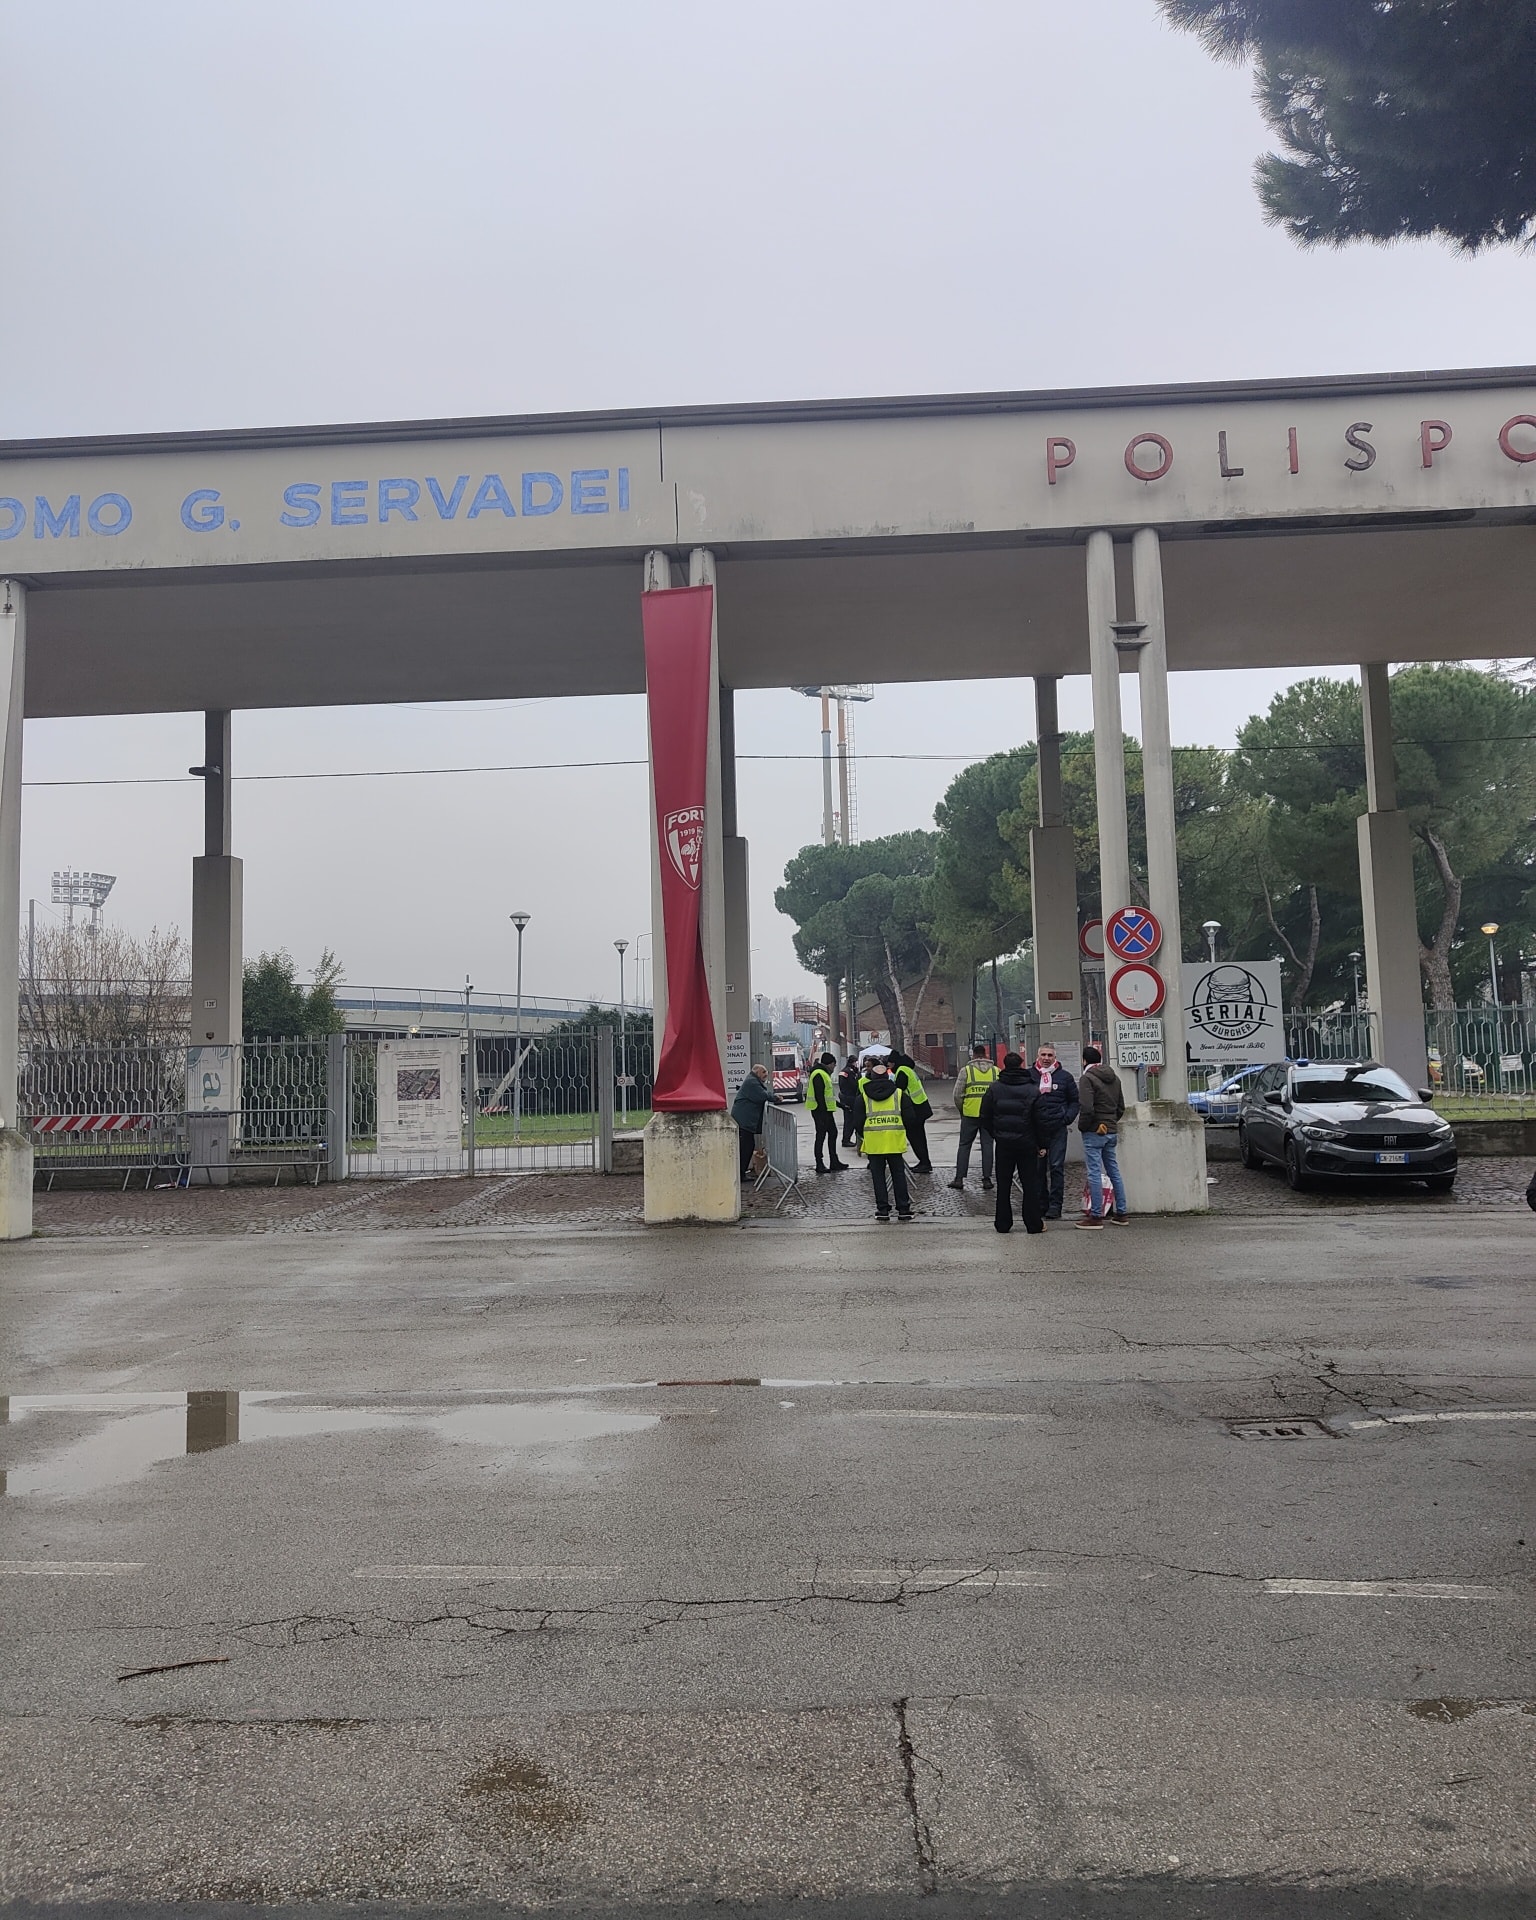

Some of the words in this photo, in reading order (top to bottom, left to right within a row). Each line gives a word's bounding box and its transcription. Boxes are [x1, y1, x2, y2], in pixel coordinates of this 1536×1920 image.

[1047, 414, 1536, 486] POLISPO
[180, 489, 241, 533] G.
[281, 467, 631, 529] SERVADEI
[1191, 1004, 1266, 1023] SERIAL
[1127, 1022, 1141, 1030] tutta
[1142, 1021, 1159, 1030] l'area
[1211, 1023, 1253, 1037] BURGHER
[1119, 1032, 1131, 1040] per
[1133, 1030, 1159, 1039] mercati
[1200, 1043, 1215, 1051] Your
[1216, 1042, 1246, 1051] Different
[1246, 1041, 1266, 1049] BBQ
[869, 1117, 899, 1125] STEWARD
[1384, 1135, 1398, 1146] FIAT
